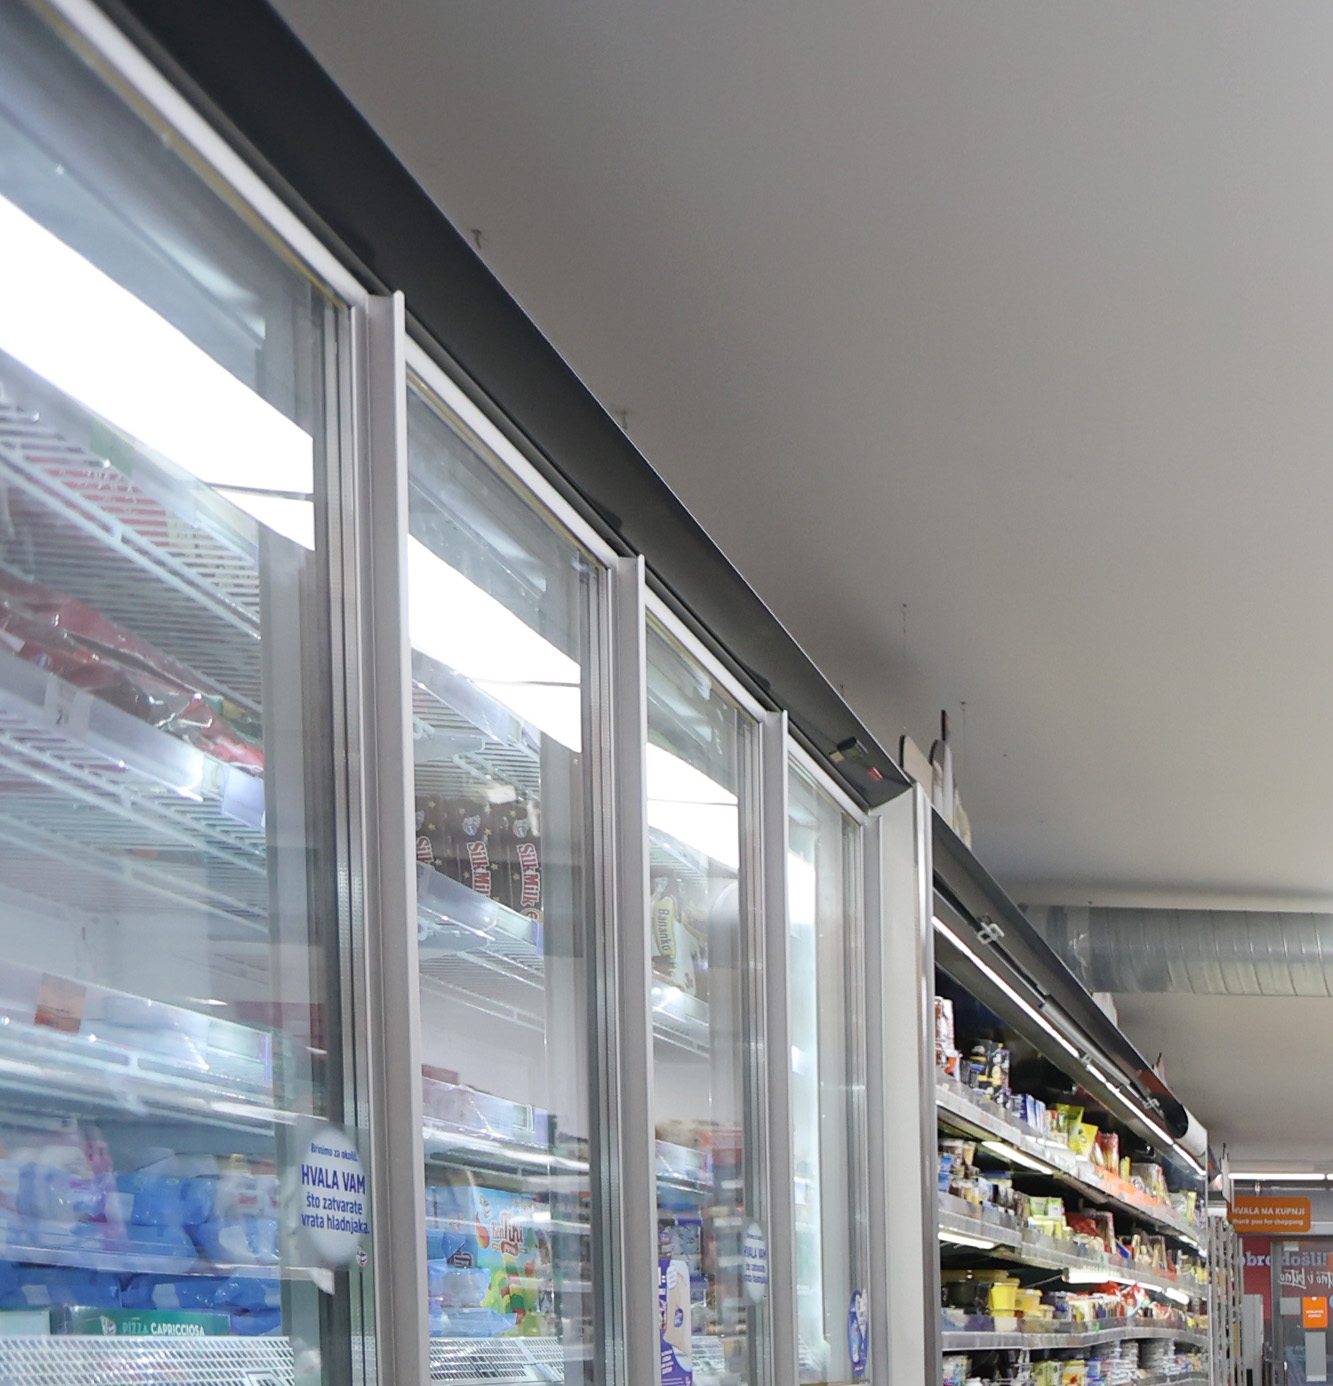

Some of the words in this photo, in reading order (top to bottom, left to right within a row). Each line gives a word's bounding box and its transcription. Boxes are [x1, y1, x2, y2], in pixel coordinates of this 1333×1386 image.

[657, 907, 672, 952] Bananko
[301, 1164, 340, 1191] HVALA
[341, 1173, 366, 1196] VAM
[306, 1193, 321, 1209] što
[322, 1197, 363, 1216] zatvarate
[301, 1215, 325, 1231] vrata
[150, 1322, 206, 1337] CAPRICCIOSA
